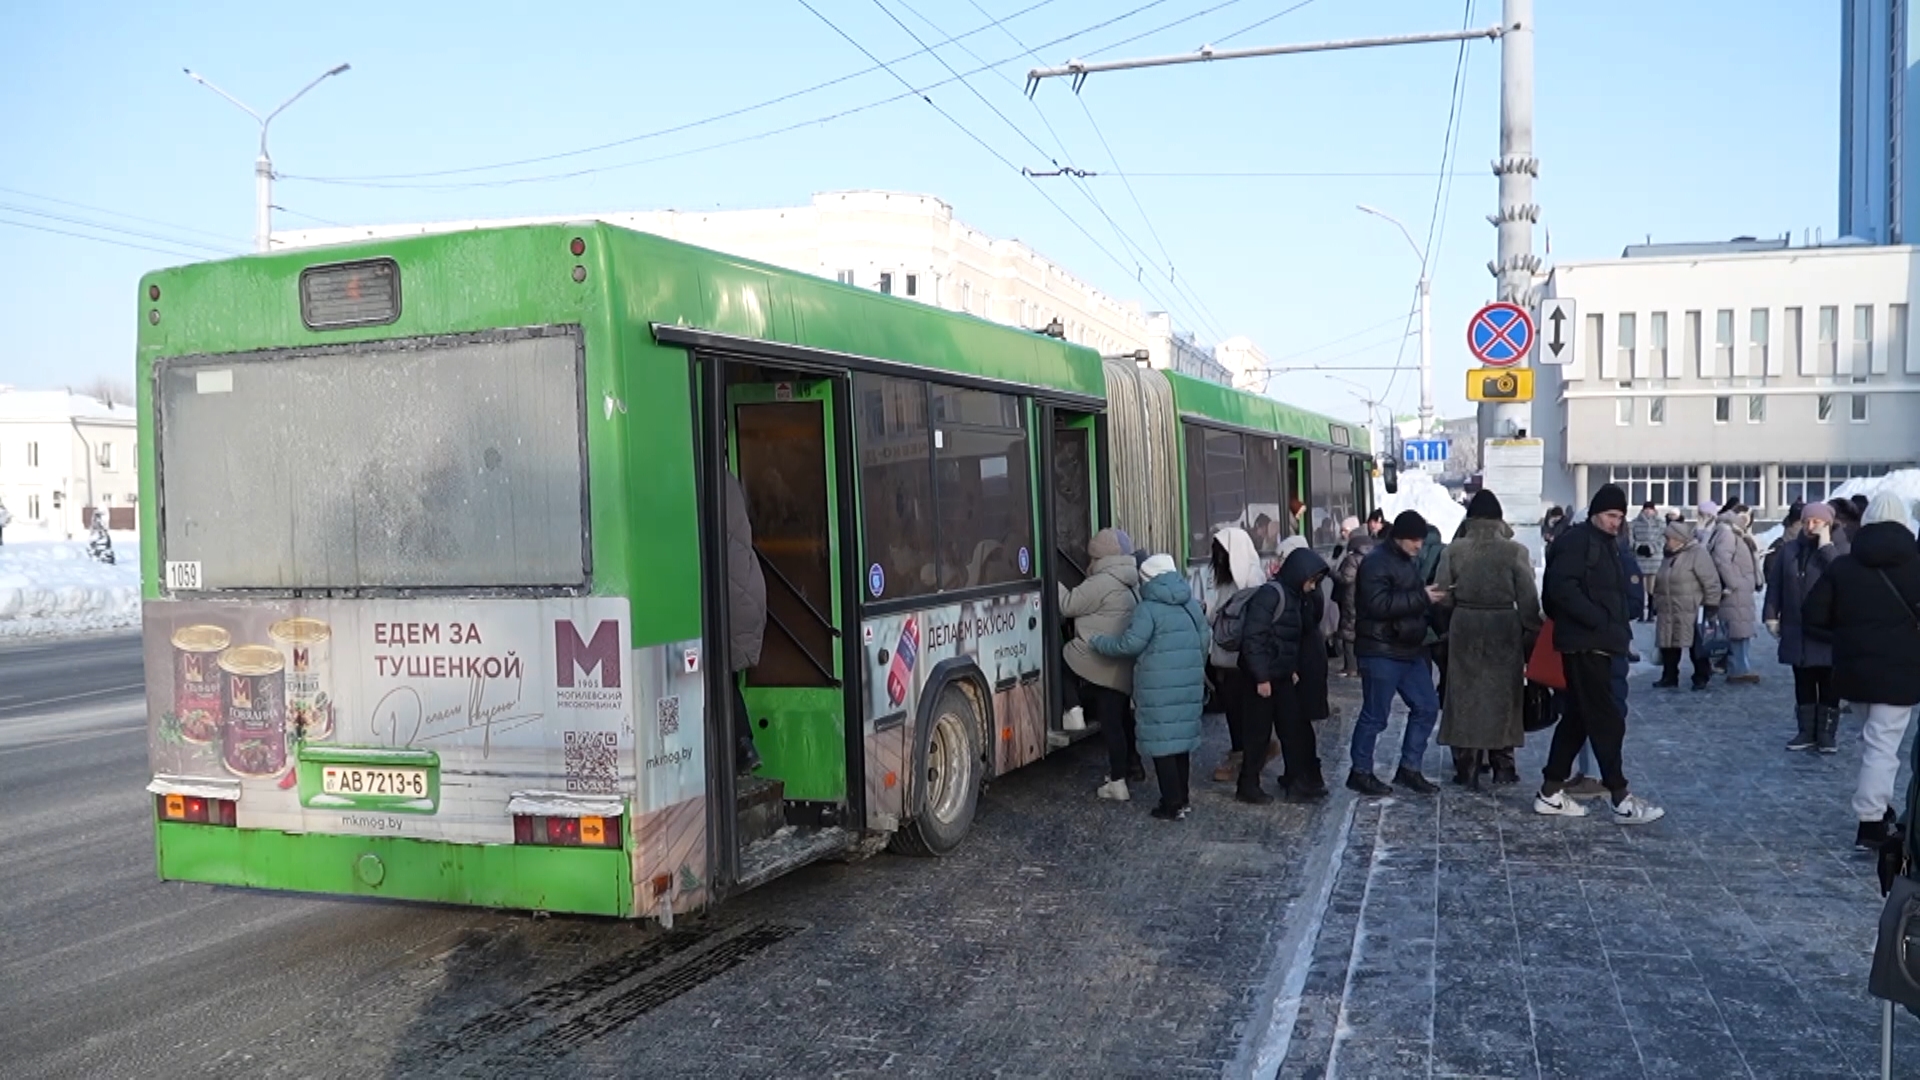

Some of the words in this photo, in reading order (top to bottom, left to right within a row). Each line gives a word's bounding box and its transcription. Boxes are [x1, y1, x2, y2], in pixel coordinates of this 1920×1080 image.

[171, 563, 197, 587] 1059
[374, 622, 440, 649] ЕДЕМ
[449, 622, 482, 645] ЗА
[927, 619, 973, 654] ДЕЛАЕМ
[977, 611, 1016, 638] ВКУСНО
[374, 649, 521, 679] ТУШЕНКОЙ
[557, 690, 622, 700] МОГИЛЕВСКИЙ
[578, 680, 598, 688] 1905
[557, 701, 622, 711] МЯСОКОМБИНАТ
[646, 747, 693, 770] mkmog.by
[342, 815, 403, 830] mkmog.by
